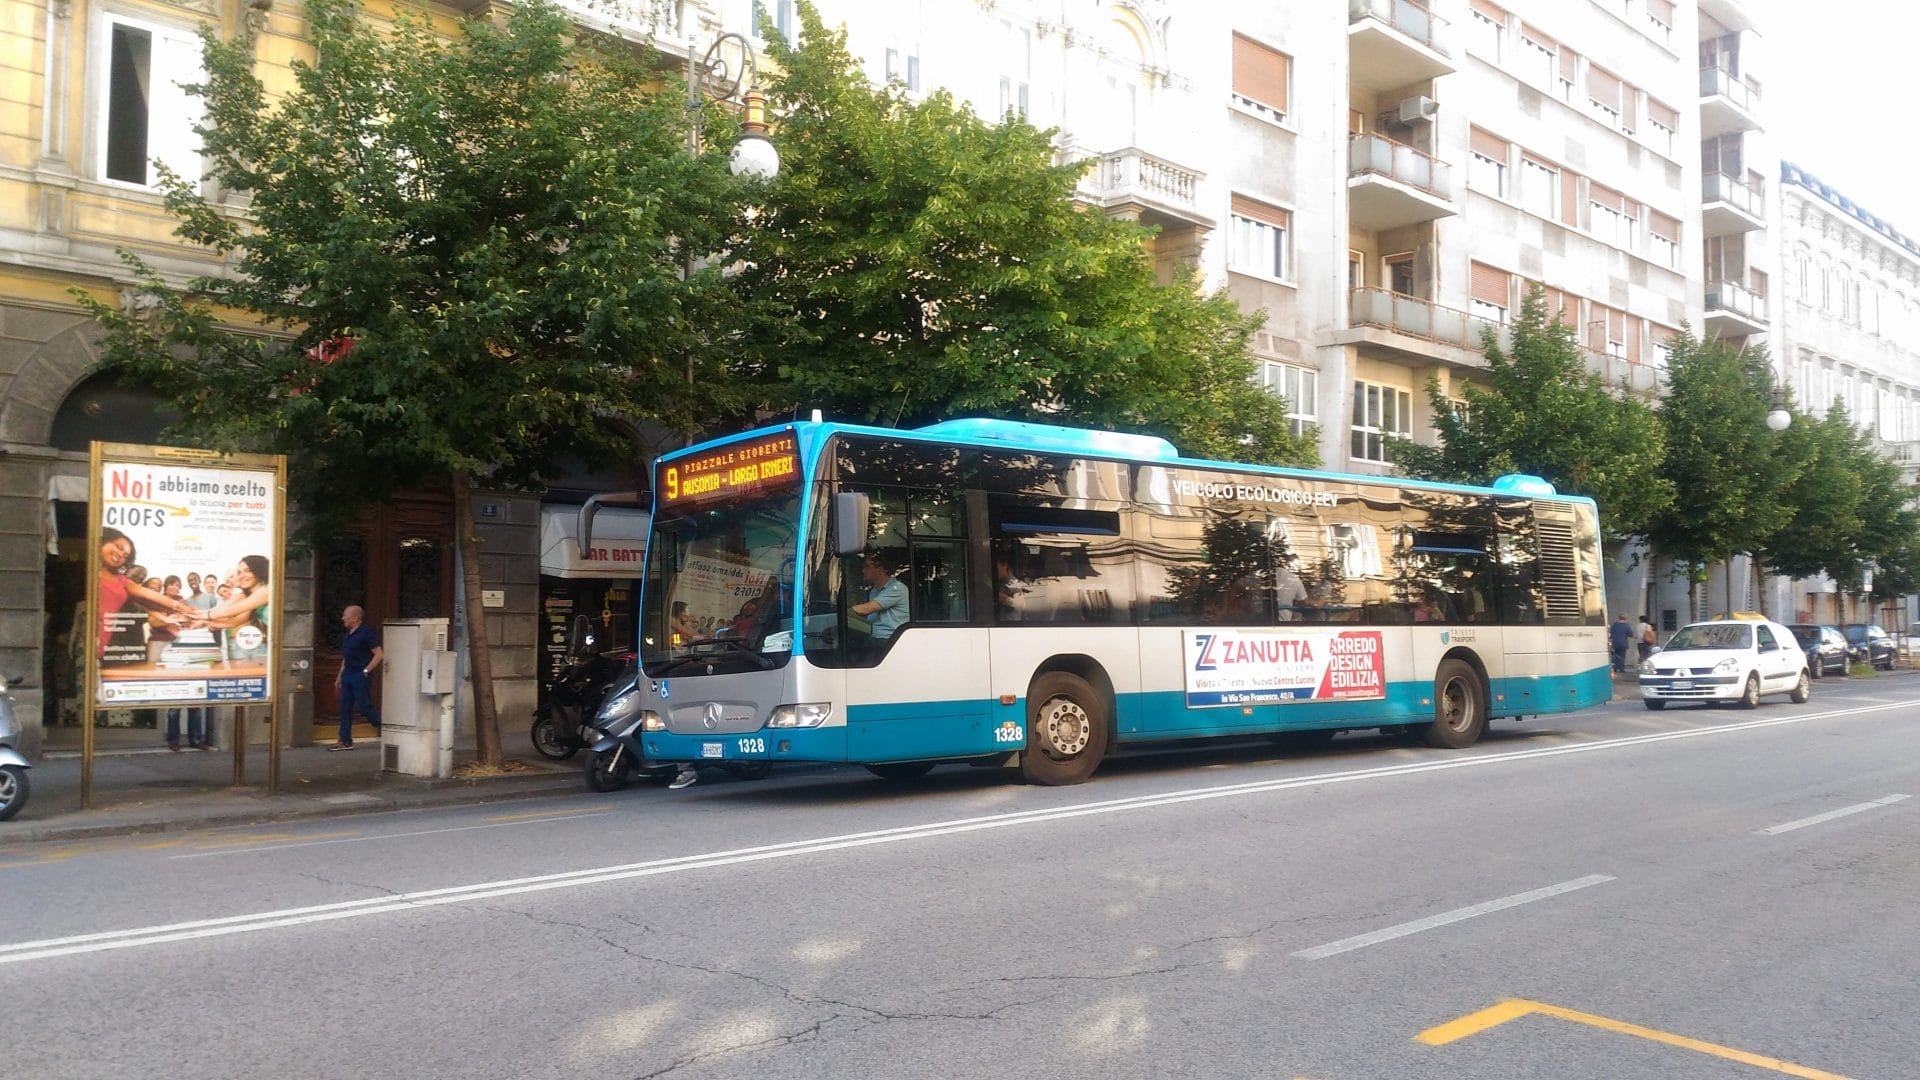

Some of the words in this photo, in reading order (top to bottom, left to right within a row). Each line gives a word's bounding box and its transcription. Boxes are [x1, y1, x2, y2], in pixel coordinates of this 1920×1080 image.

[685, 453, 734, 473] PIAZZALE
[739, 439, 792, 461] GIOBERTI
[112, 469, 152, 499] Noi
[159, 475, 219, 494] abbiamo
[224, 479, 266, 497] scelto
[667, 467, 678, 499] 9
[683, 473, 720, 496] AUSONIA
[729, 465, 758, 486] LARGO
[1172, 479, 1233, 499] VEICOLO
[1236, 486, 1312, 505] ECOLOGICO
[199, 500, 226, 508] scuola
[228, 501, 243, 510] per
[246, 501, 266, 509] tutti
[106, 506, 165, 527] CIOFS
[580, 549, 608, 560] AR
[612, 549, 647, 561] BATT
[1222, 640, 1314, 664] ZANUTTA
[1330, 637, 1377, 654] ARREDO
[1330, 653, 1372, 671] DESIGN
[1273, 676, 1294, 685] Centro
[1331, 670, 1379, 688] EDILIZIA
[994, 726, 1023, 742] 1328
[738, 737, 765, 753] 1328
